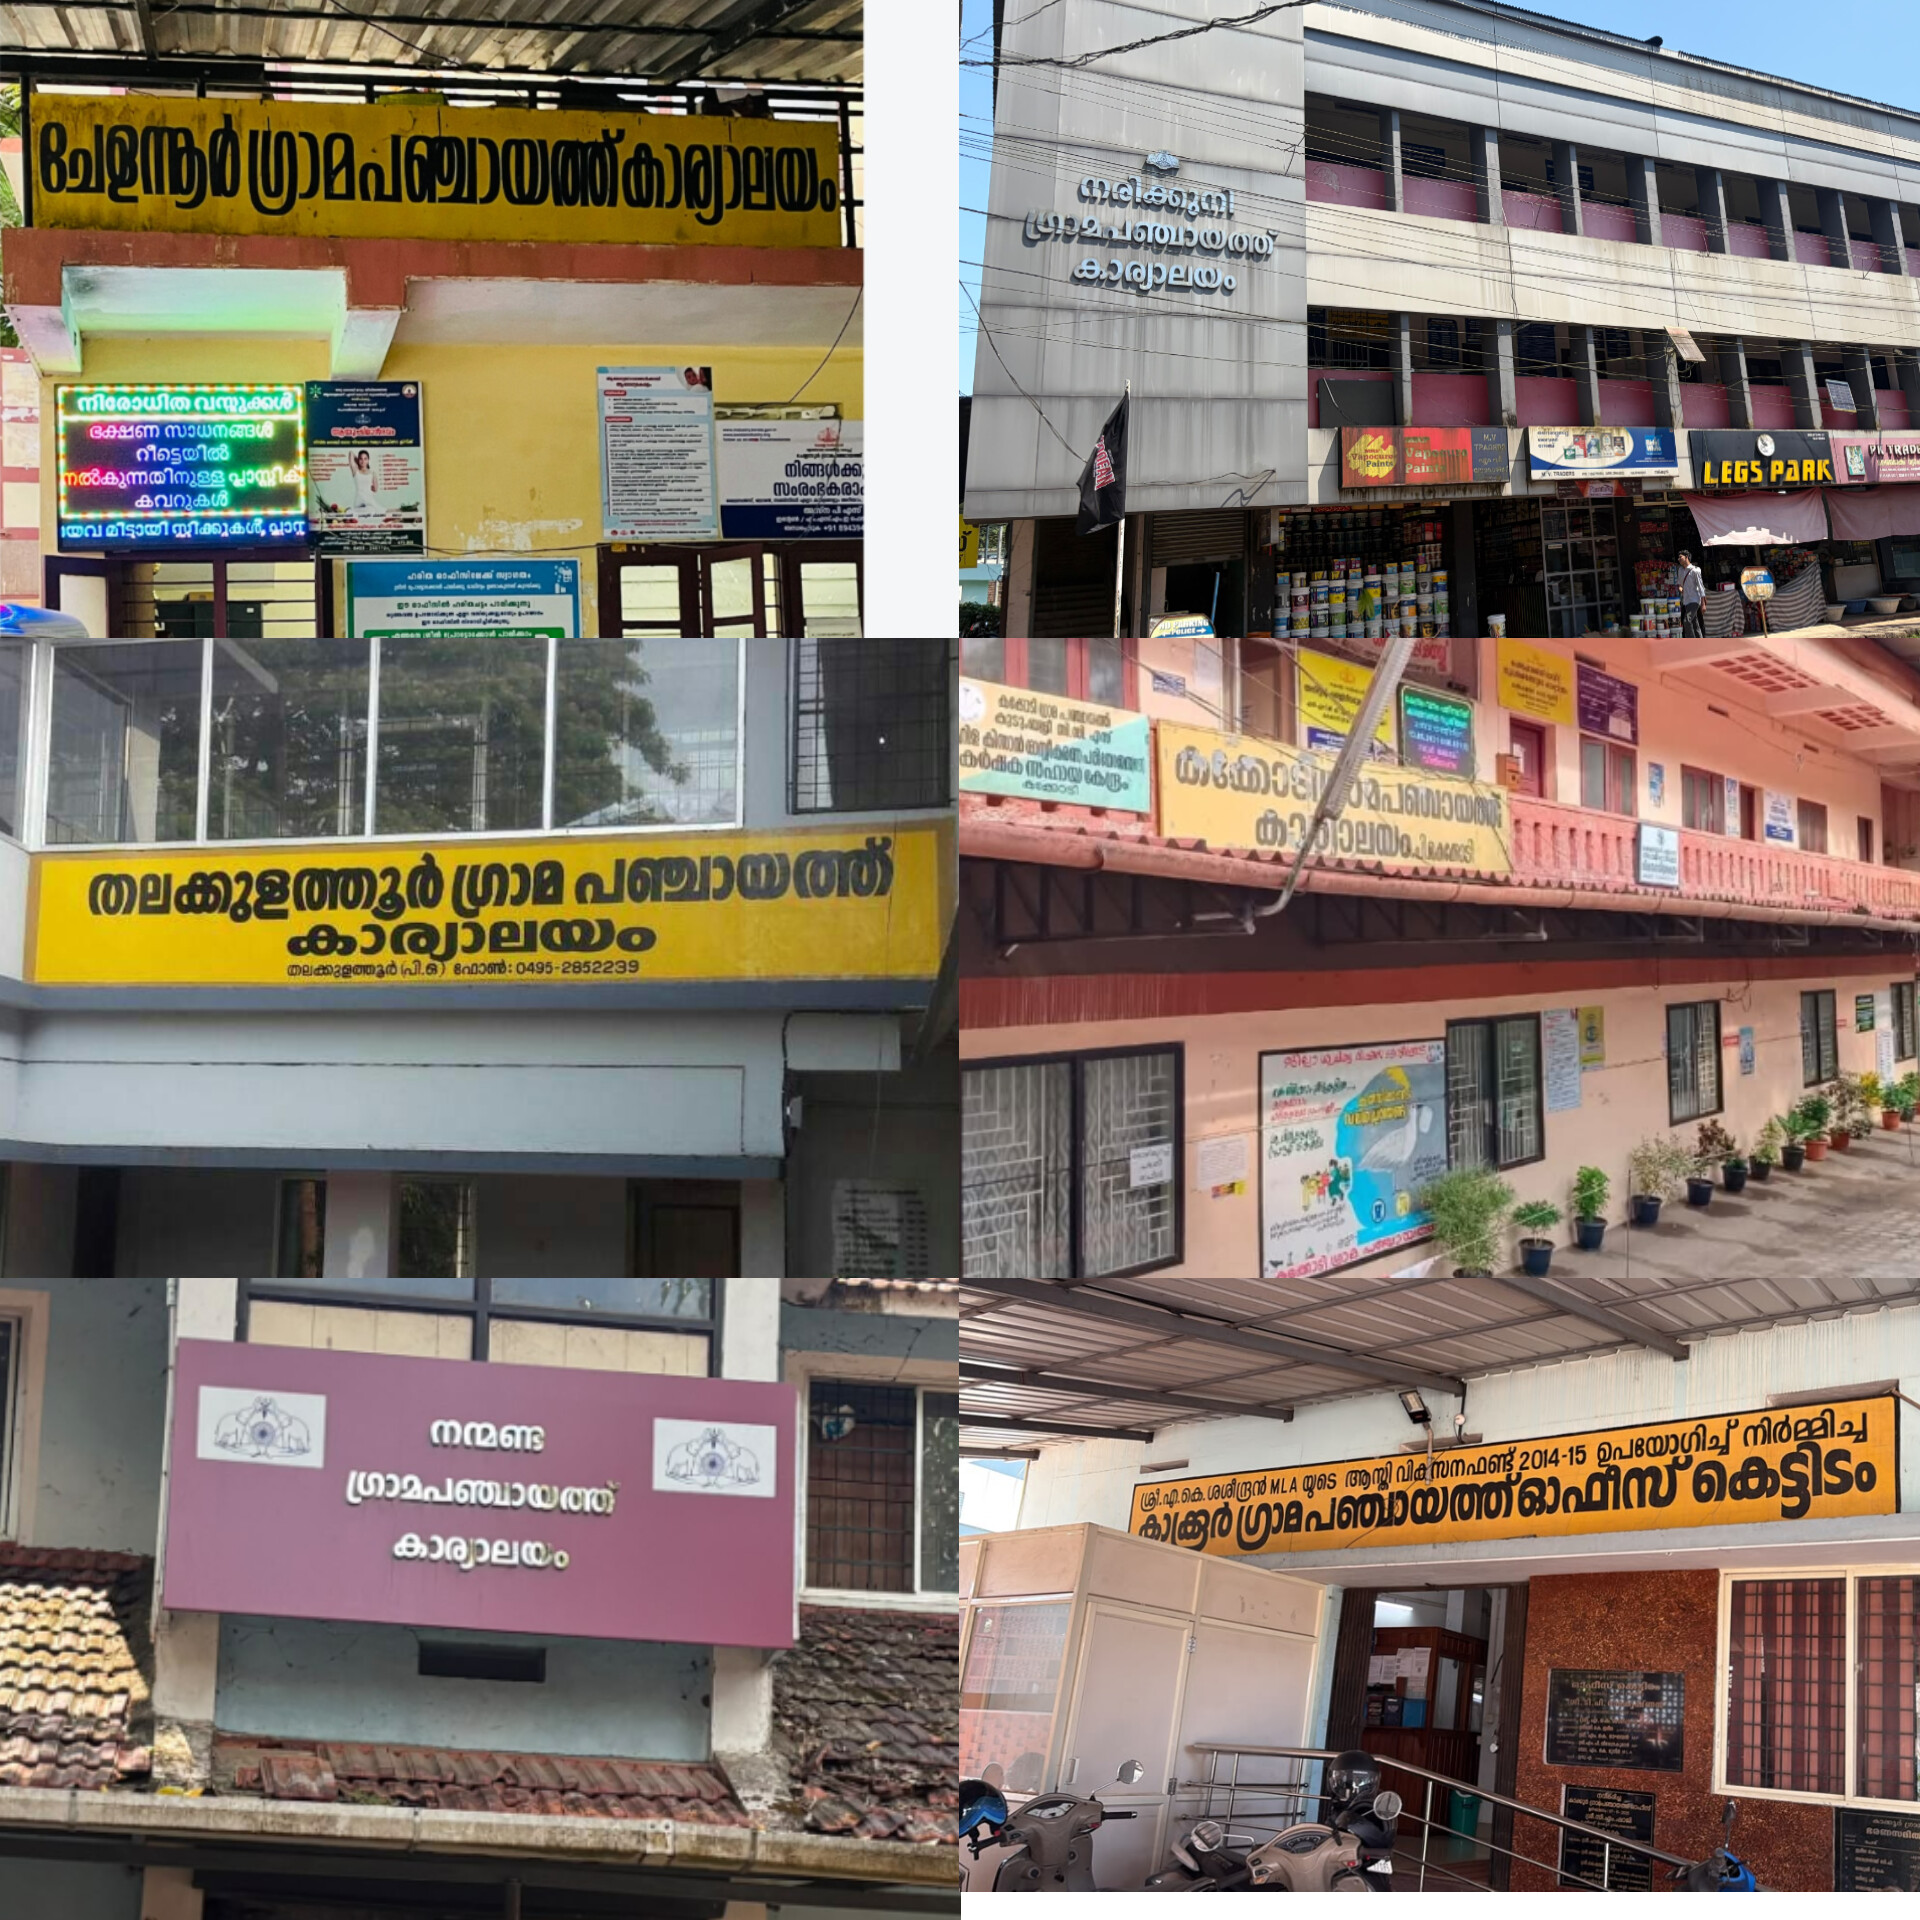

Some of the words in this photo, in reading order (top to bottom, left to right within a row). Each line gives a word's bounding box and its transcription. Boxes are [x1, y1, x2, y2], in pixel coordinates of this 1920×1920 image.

[622, 141, 837, 226] കാര്യാലയം
[1080, 174, 1236, 217] നരിക്കുനി
[1024, 208, 1279, 256] ഗ്രാമപഞ്ചായത്ത്
[1074, 257, 1237, 291] കാര്യാലയം
[77, 392, 190, 412] നിരോധിത
[89, 422, 160, 439] ഭക്ഷണ
[164, 420, 275, 438] സാധനങ്ങൾ
[1351, 453, 1393, 461] Vapocure
[1366, 460, 1394, 468] Paints
[1405, 447, 1468, 460] Vapocure
[1405, 462, 1447, 474] Paints
[1704, 460, 1763, 484] LEGS
[1770, 459, 1834, 482] PARK
[134, 489, 230, 511] കവറുകൾ
[824, 524, 837, 532] +91
[1160, 621, 1171, 630] NO
[1173, 619, 1209, 628] PARKING
[1171, 627, 1196, 635] POLICE
[88, 851, 444, 923] തലക്കുളത്തൂർ
[452, 859, 565, 918] ഗ്രാമ
[575, 836, 894, 904] പഞ്ചായത്ത്
[287, 917, 657, 962] കാര്യാലയം
[287, 960, 397, 978] തലക്കുളത്തൂർ
[516, 958, 640, 976] 0495-2852239
[431, 1419, 546, 1452] നന്മണ്ട
[1270, 1476, 1298, 1495] MLA
[1302, 1472, 1337, 1498] യുടെ
[1519, 1444, 1587, 1471] 2014-15
[1597, 1418, 1739, 1466] ഉപയോഗിച്ച്
[346, 1469, 621, 1514] ഗ്രാമപഞ്ചായത്ത്
[1692, 1441, 1877, 1518] കെട്ടിടം
[393, 1532, 571, 1571] കാര്യാലയം
